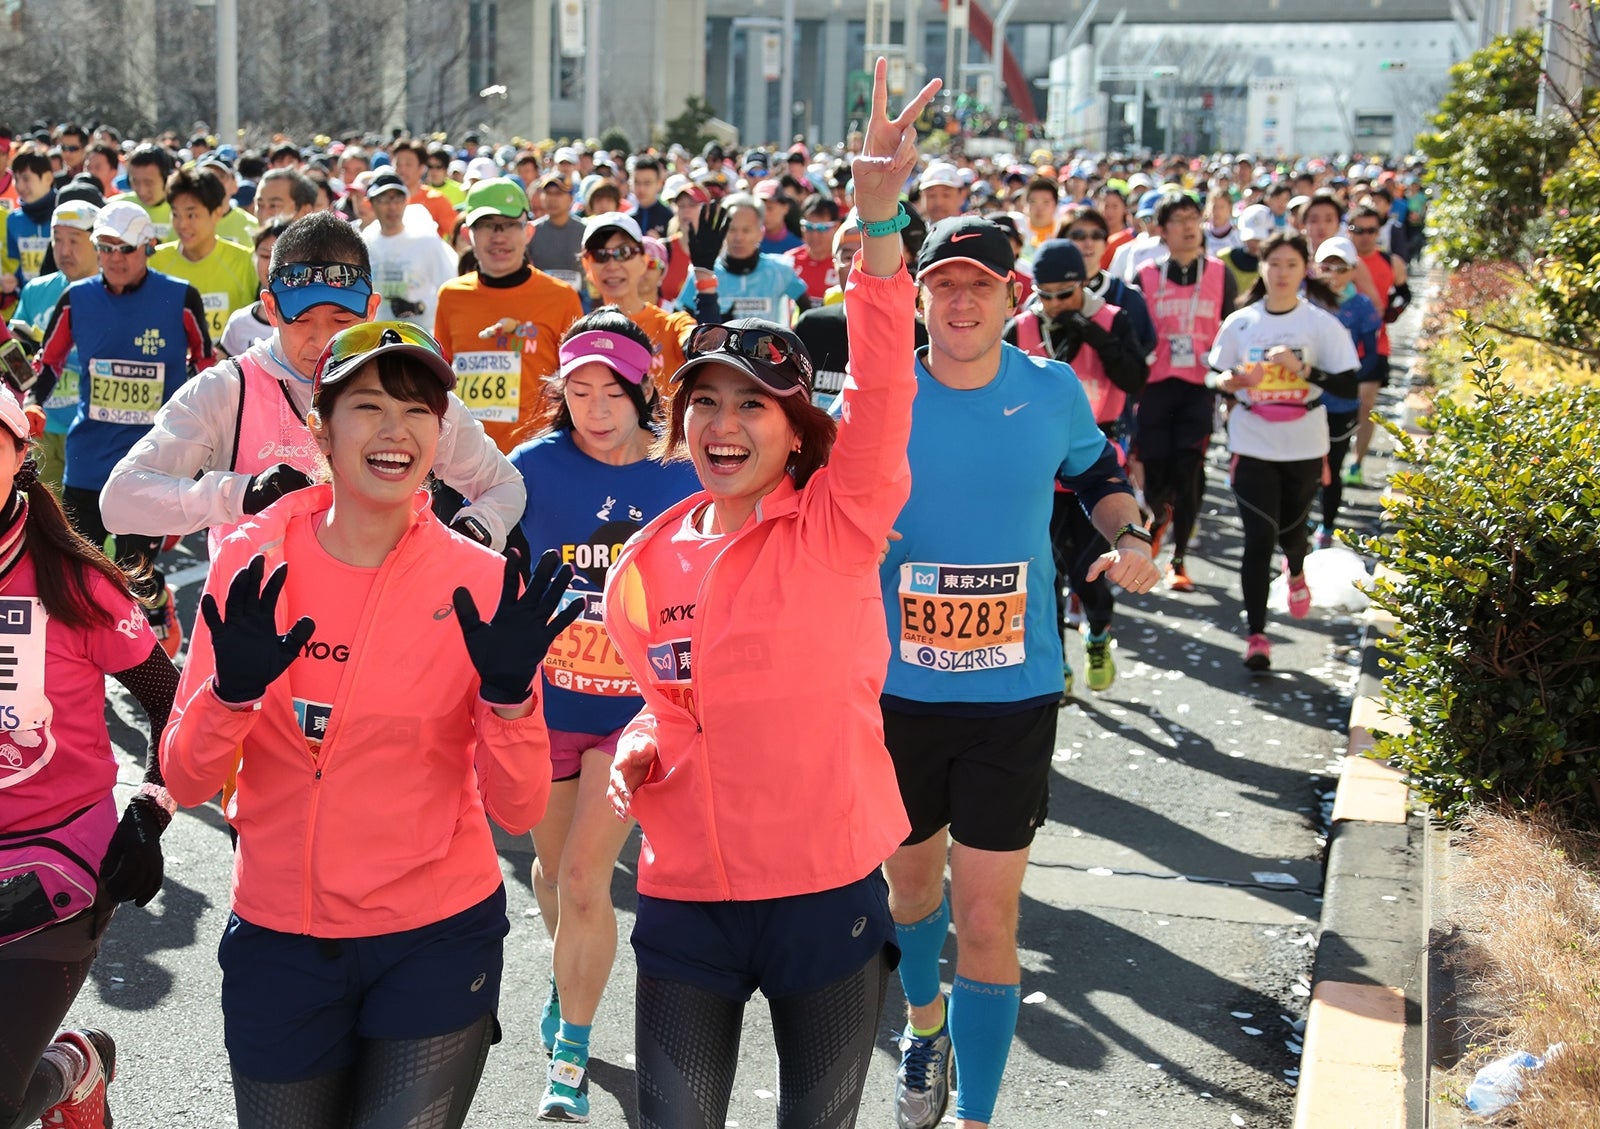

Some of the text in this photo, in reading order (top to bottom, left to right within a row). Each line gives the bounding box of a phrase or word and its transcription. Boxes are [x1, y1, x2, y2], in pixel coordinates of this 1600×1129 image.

[468, 355, 511, 371] STARTS
[92, 378, 150, 404] E27988
[457, 376, 506, 399] 1668
[943, 573, 1015, 589] 東京メトロ
[903, 597, 1008, 640] E83283
[904, 632, 935, 645] GATE 5
[297, 641, 350, 662] YOG
[937, 646, 1008, 671] STARTS
[545, 657, 575, 669] GATE 4
